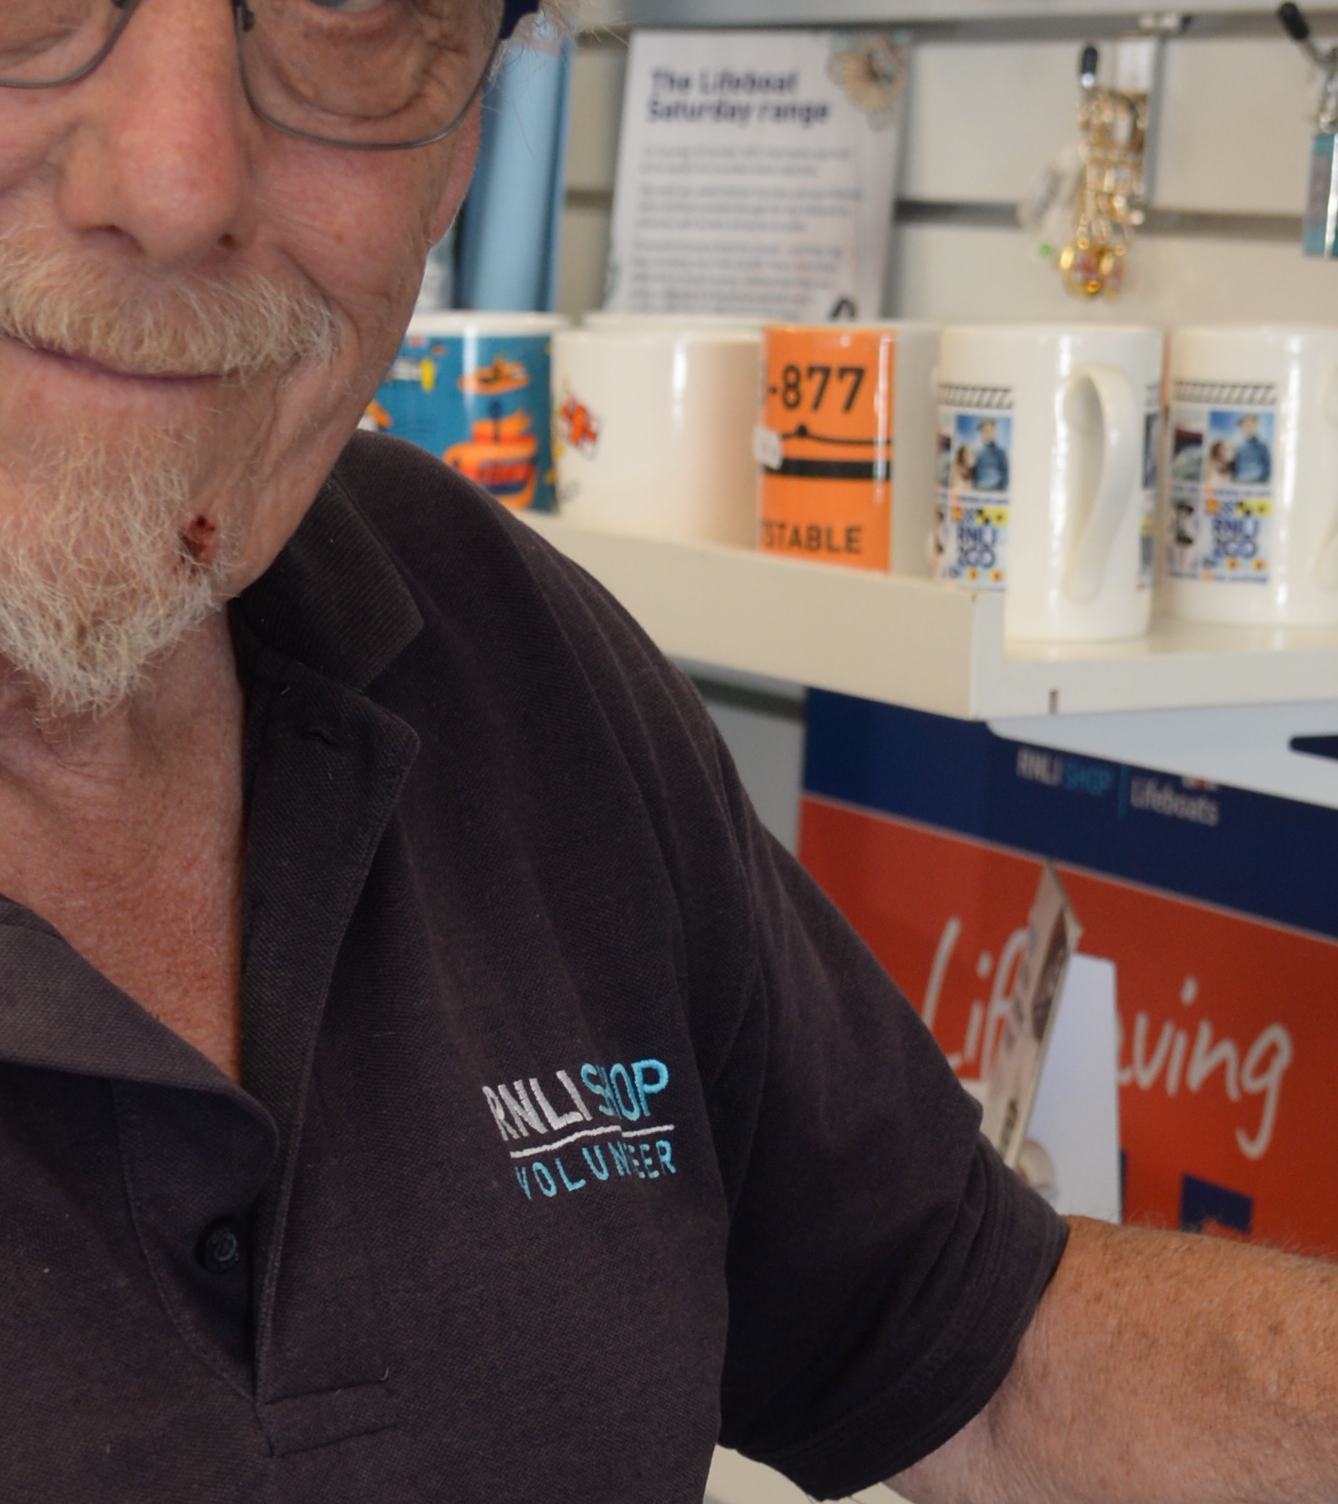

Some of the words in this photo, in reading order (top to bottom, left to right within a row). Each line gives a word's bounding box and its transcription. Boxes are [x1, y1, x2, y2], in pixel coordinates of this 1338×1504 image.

[650, 67, 692, 96] The
[699, 65, 800, 97] Lifeboat
[647, 99, 755, 128] Saturday
[759, 101, 831, 129] range
